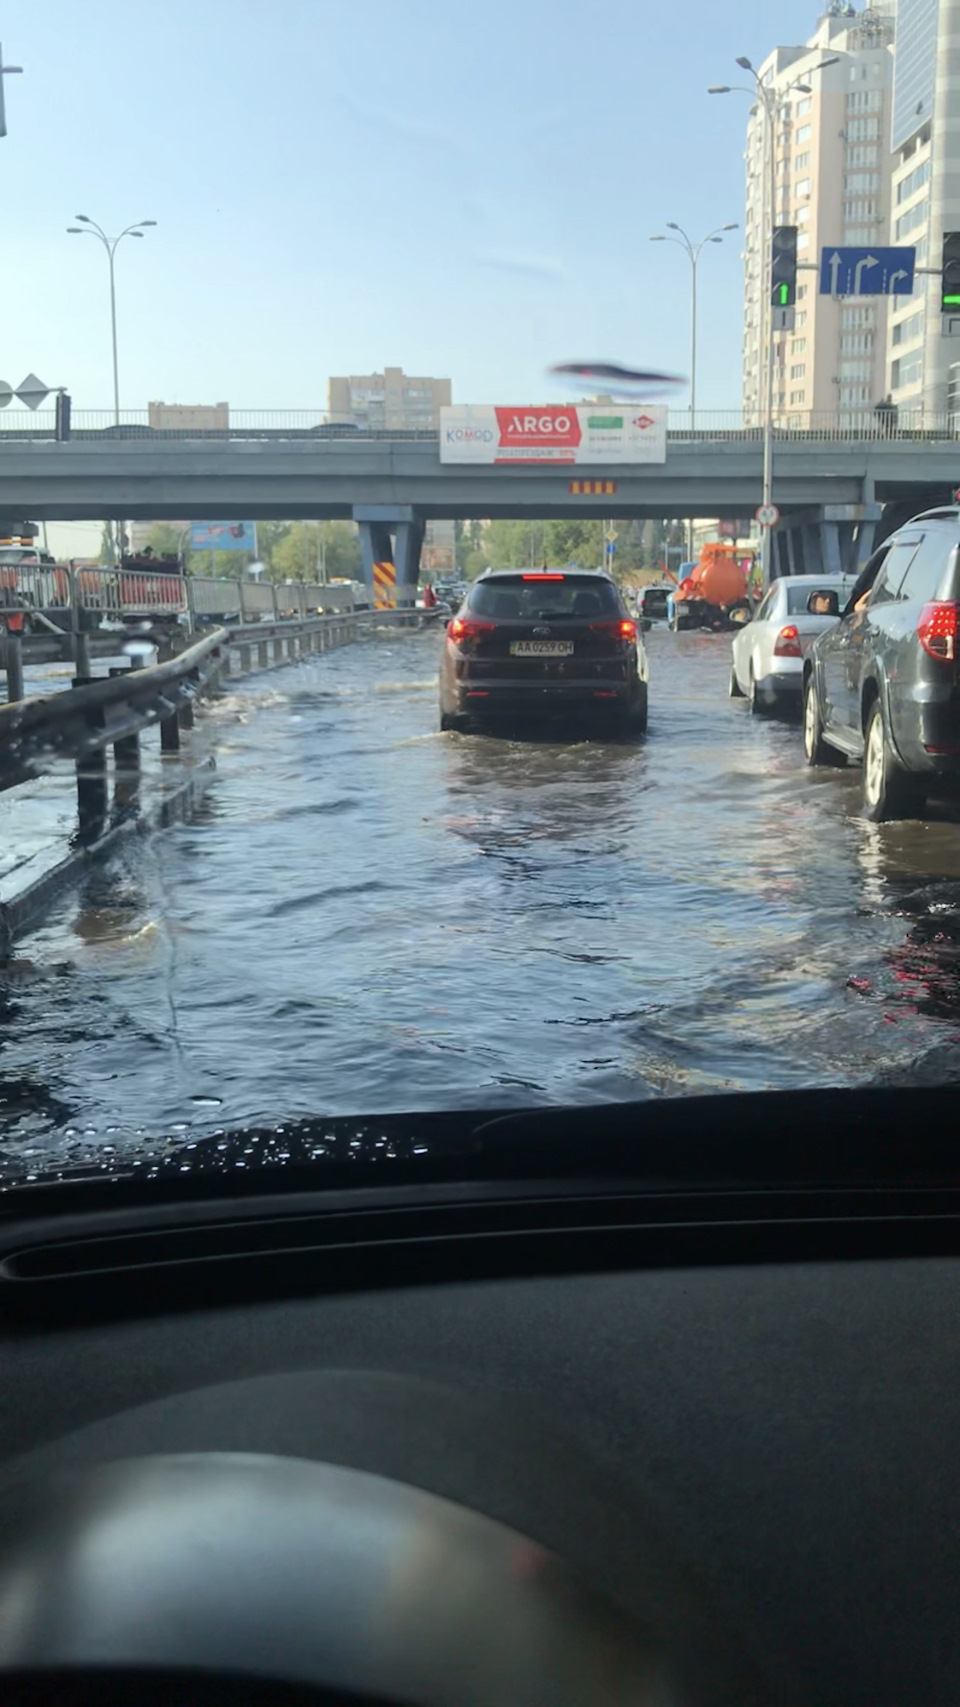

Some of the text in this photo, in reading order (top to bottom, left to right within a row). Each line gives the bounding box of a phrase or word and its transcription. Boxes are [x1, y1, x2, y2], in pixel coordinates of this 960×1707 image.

[507, 416, 571, 433] ARGO
[446, 429, 494, 443] KOMOD
[517, 642, 573, 652] AA 0259 OH
